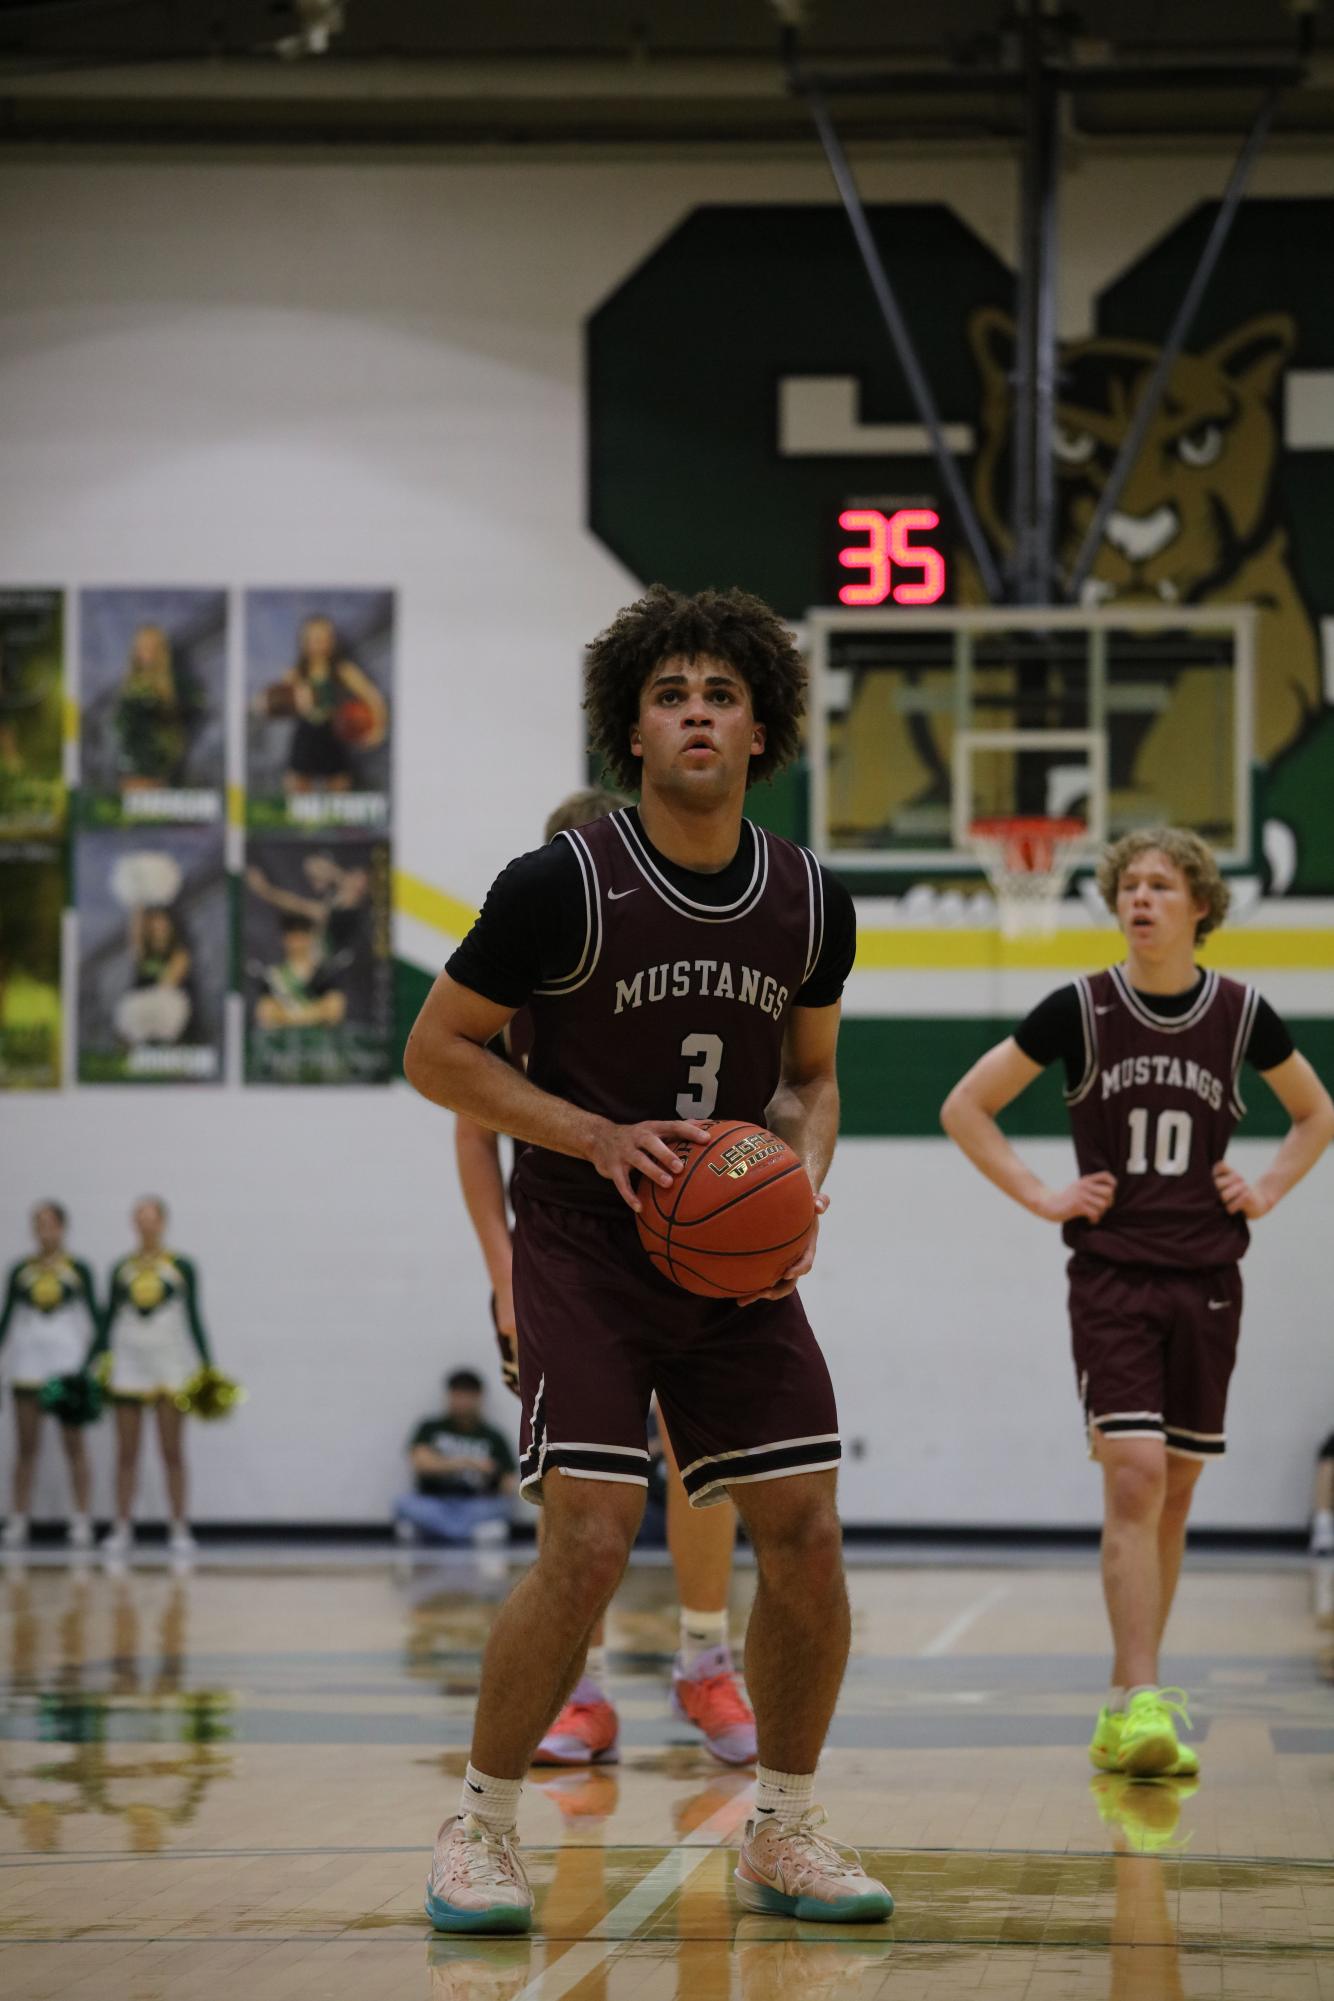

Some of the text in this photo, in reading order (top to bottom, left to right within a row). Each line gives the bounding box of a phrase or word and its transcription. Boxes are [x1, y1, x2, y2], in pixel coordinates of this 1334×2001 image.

[838, 509, 946, 605] 35
[613, 960, 789, 1021] MUSTANGS
[675, 1033, 723, 1119] 3
[1101, 1055, 1223, 1111] MUSTANGS
[1126, 1108, 1192, 1176] 10
